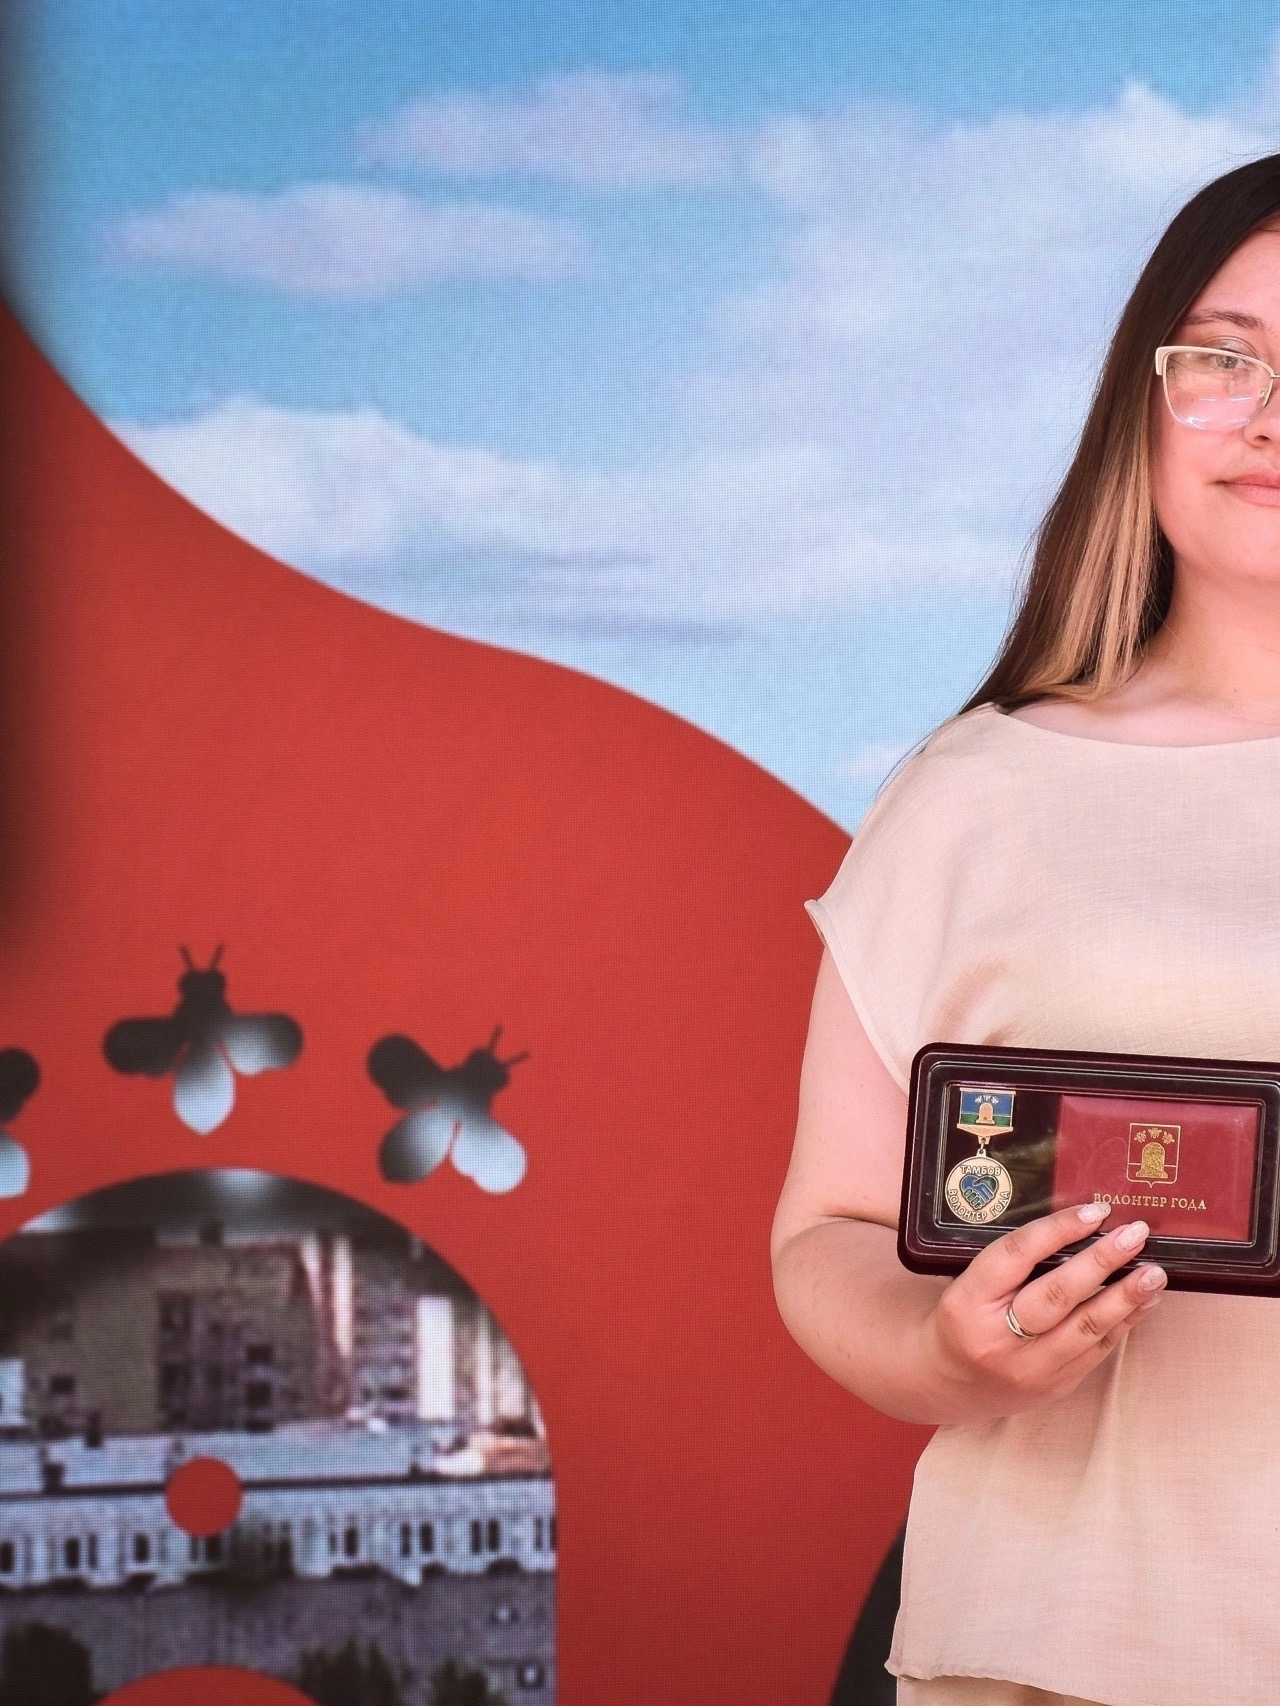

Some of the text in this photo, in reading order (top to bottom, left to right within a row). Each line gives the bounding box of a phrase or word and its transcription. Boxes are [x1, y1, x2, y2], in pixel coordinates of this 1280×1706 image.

[960, 1165, 1001, 1176] ТАМБОВ
[948, 1189, 1010, 1220] ВОЛОНТЕР ГОДА
[1093, 1193, 1207, 1211] ВОЛОНТЕР ГОДА
